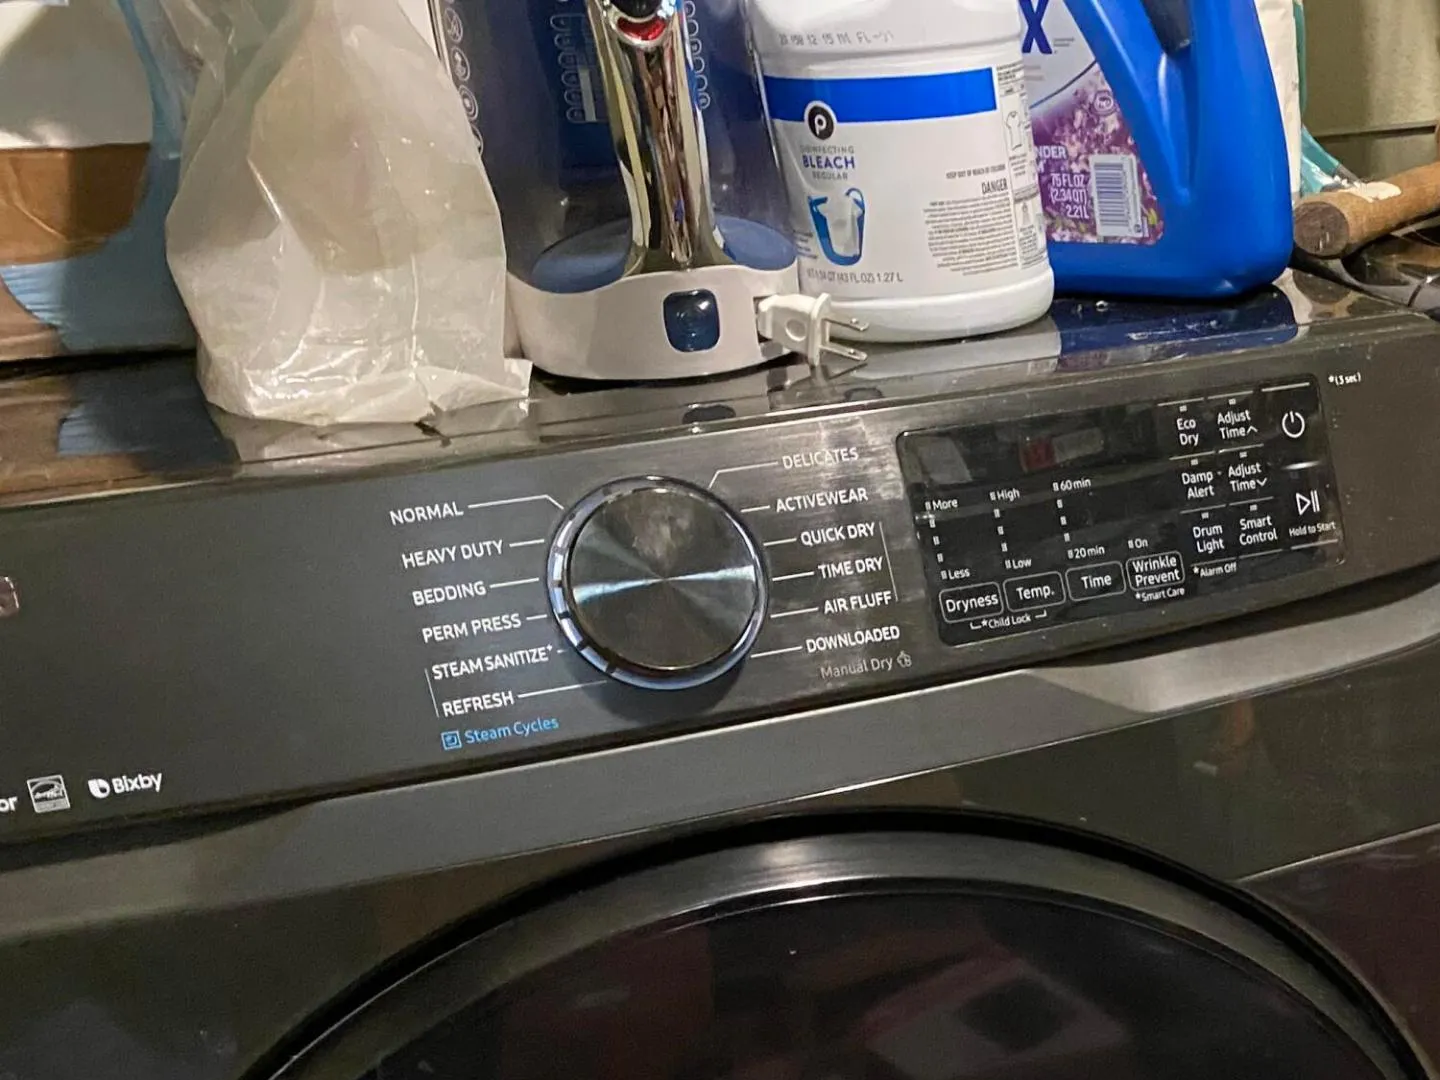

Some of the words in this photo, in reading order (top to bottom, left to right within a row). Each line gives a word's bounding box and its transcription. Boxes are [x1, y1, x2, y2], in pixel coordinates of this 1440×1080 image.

[802, 155, 855, 169] BLEACH
[981, 178, 1008, 194] DANGER
[1062, 173, 1073, 187] FL
[1073, 174, 1085, 188] OZ
[1176, 418, 1196, 430] Eco
[1217, 409, 1251, 425] Adjust
[1179, 433, 1199, 446] Dry
[1219, 427, 1246, 439] Time
[782, 447, 859, 469] DELICATES
[1181, 471, 1214, 485] Damp
[1228, 462, 1262, 478] Adjust
[1060, 481, 1072, 492] 60
[1073, 478, 1091, 488] min
[1187, 485, 1215, 499] Alert
[1230, 479, 1256, 492] Time
[776, 487, 868, 513] ACTIVEWEAR
[996, 488, 1020, 502] High
[932, 498, 958, 510] More
[389, 501, 464, 525] NORMAL
[1193, 524, 1223, 538] Drum
[1239, 515, 1272, 531] Smart
[1289, 526, 1307, 538] Hold
[1308, 525, 1316, 534] to
[1317, 521, 1336, 532] Start
[800, 526, 847, 547] QUICK
[847, 522, 875, 539] DRY
[1239, 528, 1278, 546] Control
[1134, 538, 1148, 549] On
[1197, 538, 1225, 554] Light
[402, 545, 457, 568] HEAVY
[461, 539, 503, 559] DUTY
[1075, 547, 1086, 559] 20
[1087, 545, 1105, 556] min
[818, 560, 854, 579] TIME
[855, 556, 883, 573] DRY
[1012, 559, 1032, 570] Low
[1132, 555, 1177, 574] Wrinkle
[1200, 565, 1223, 578] Alarm
[1224, 562, 1237, 574] Off
[948, 568, 970, 579] Less
[1081, 573, 1112, 589] Time
[1135, 568, 1180, 587] Prevent
[412, 581, 486, 606] BEDDING
[1016, 584, 1056, 600] Temp.
[1166, 586, 1185, 598] Care
[824, 598, 848, 614] AIR
[850, 591, 892, 610] FLUFF
[945, 593, 999, 613] Dryness
[1011, 613, 1031, 625] Lock
[422, 622, 468, 643] PERM
[471, 613, 522, 635] PRESS
[805, 625, 900, 653] DOWNLOADED
[432, 657, 483, 680] STEAM
[820, 658, 869, 679] Manual
[871, 657, 893, 671] Dry
[442, 691, 514, 717] REFRESH
[465, 725, 511, 744] Steam
[513, 718, 559, 737] Cycles
[112, 773, 162, 794] Bixby
